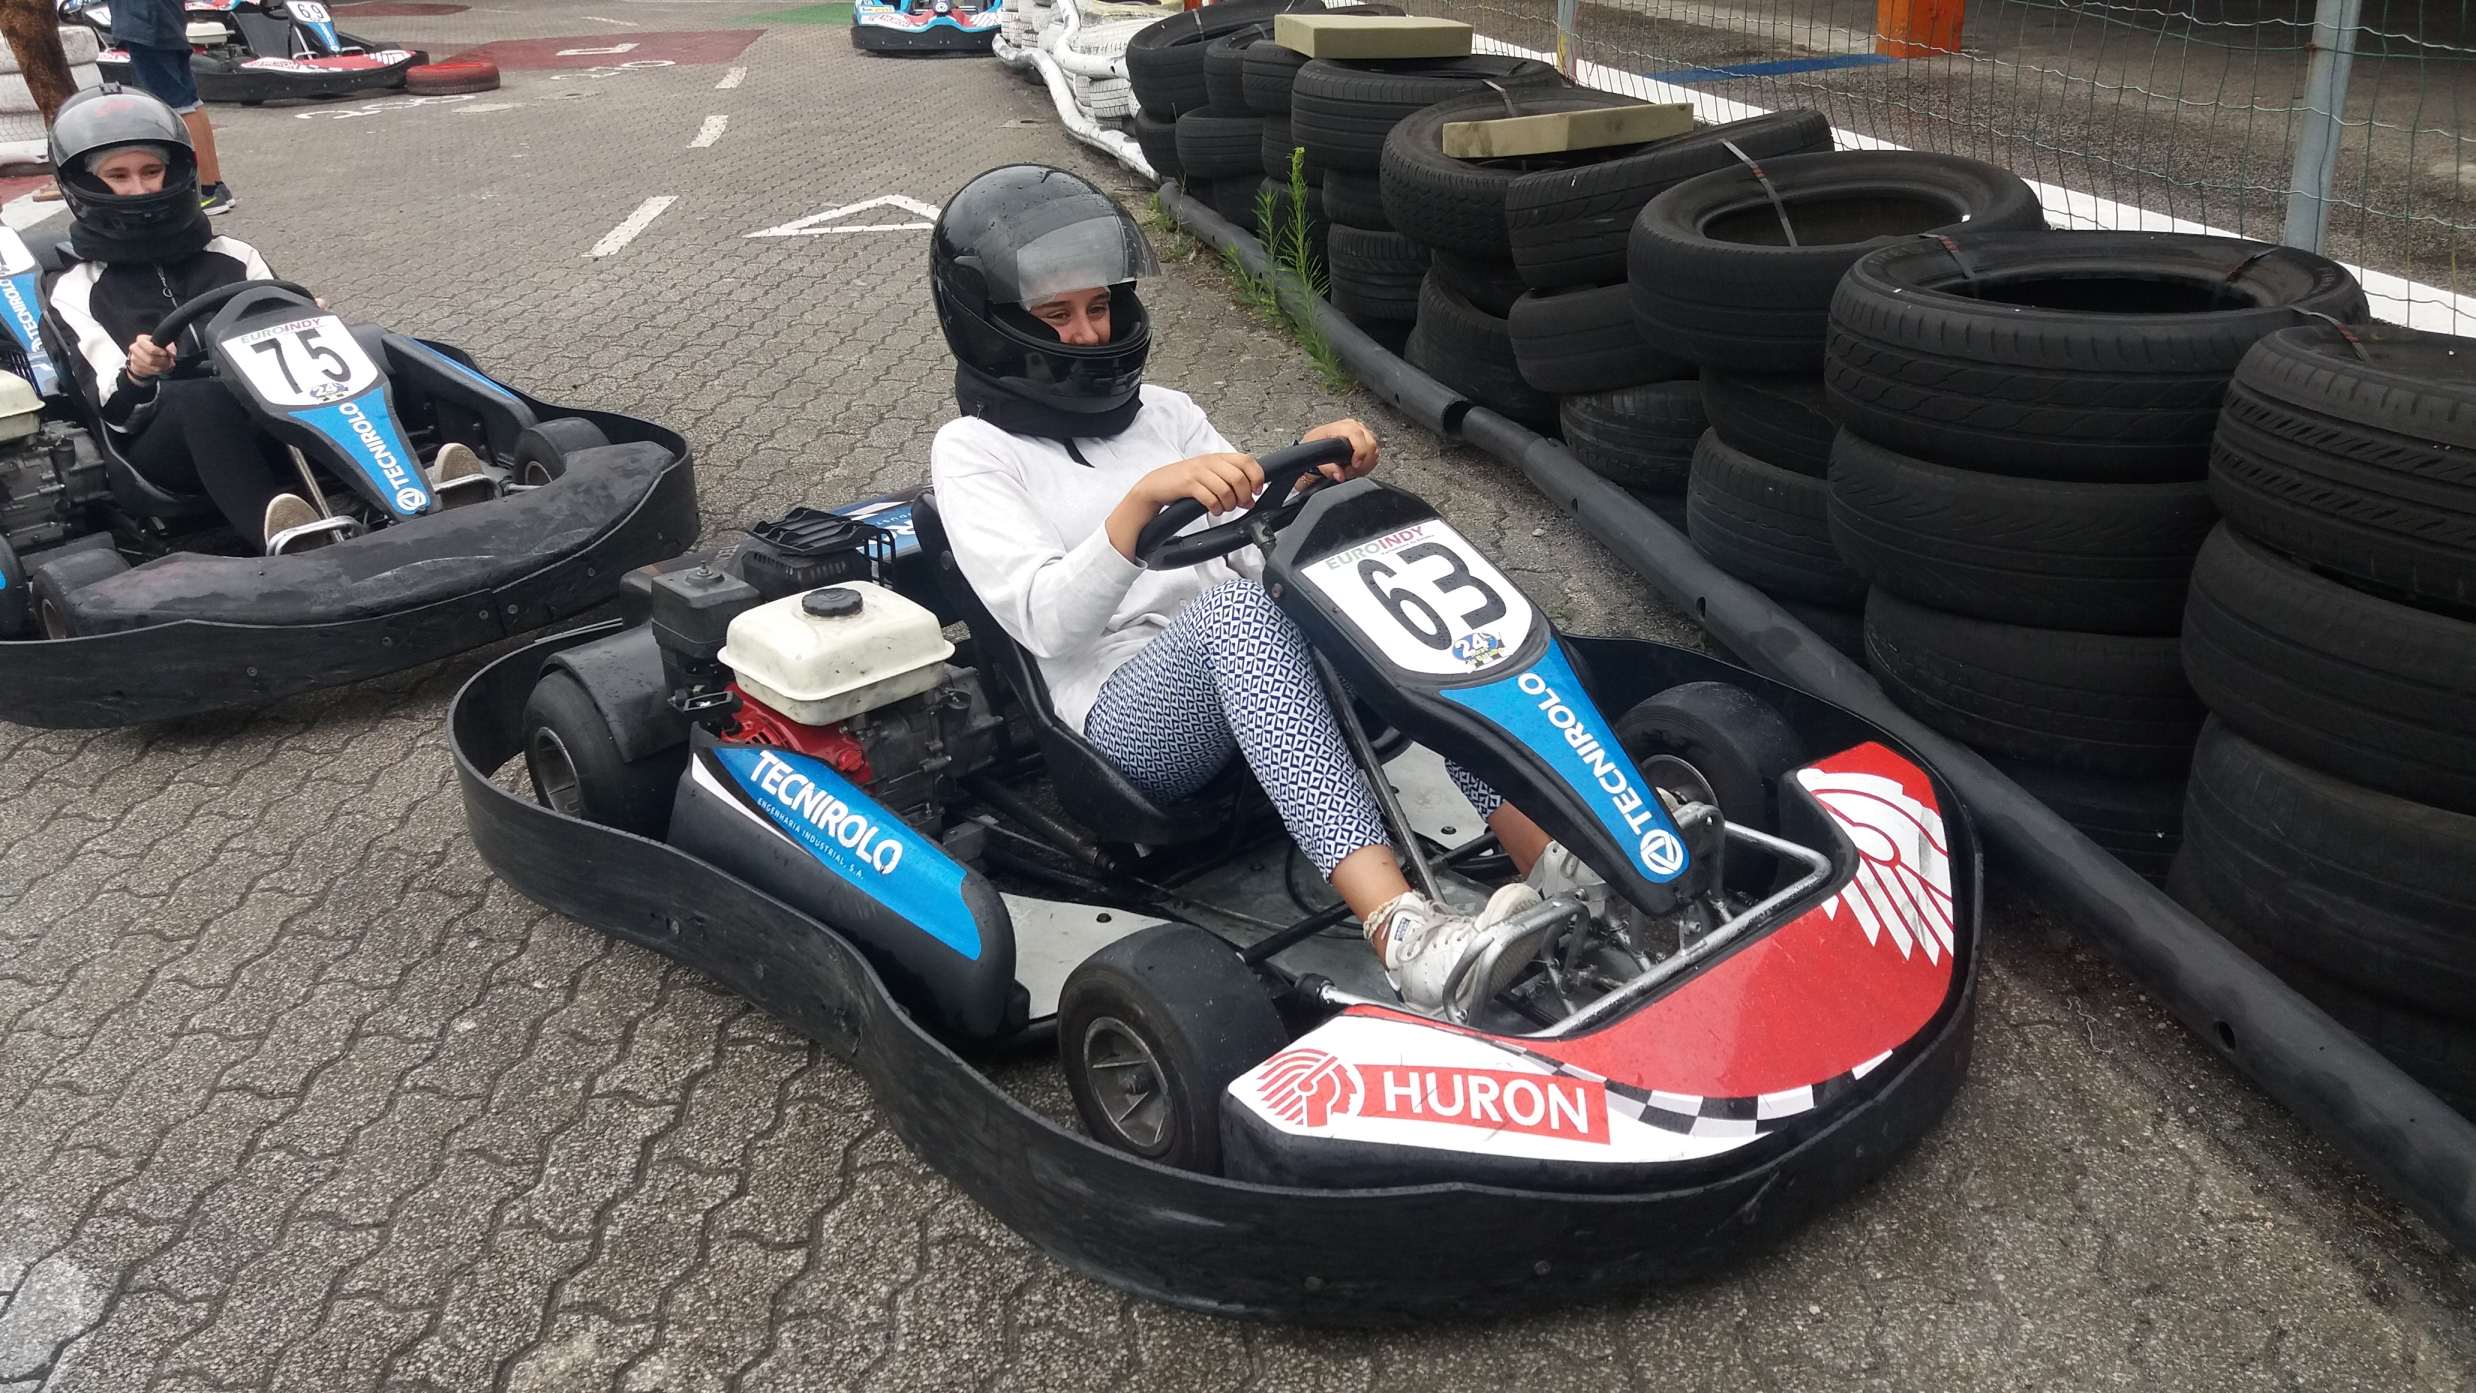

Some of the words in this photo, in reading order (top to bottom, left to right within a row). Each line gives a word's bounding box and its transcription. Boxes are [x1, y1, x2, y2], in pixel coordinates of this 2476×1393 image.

[297, 3, 325, 19] 69
[240, 317, 321, 344] EUROINDY
[250, 328, 351, 395] 75
[339, 402, 410, 491] TECNIROLO
[1324, 525, 1425, 571] EUROINDY
[1357, 542, 1507, 650] 63
[1454, 632, 1490, 659] 24
[1517, 672, 1653, 836] TECNIROLO
[750, 750, 903, 875] TECNIROLO
[757, 797, 801, 833] ENGENHARIA
[802, 829, 846, 870] INDUSTRIAL,
[849, 863, 865, 880] S.A.
[1383, 1070, 1590, 1134] HURON
